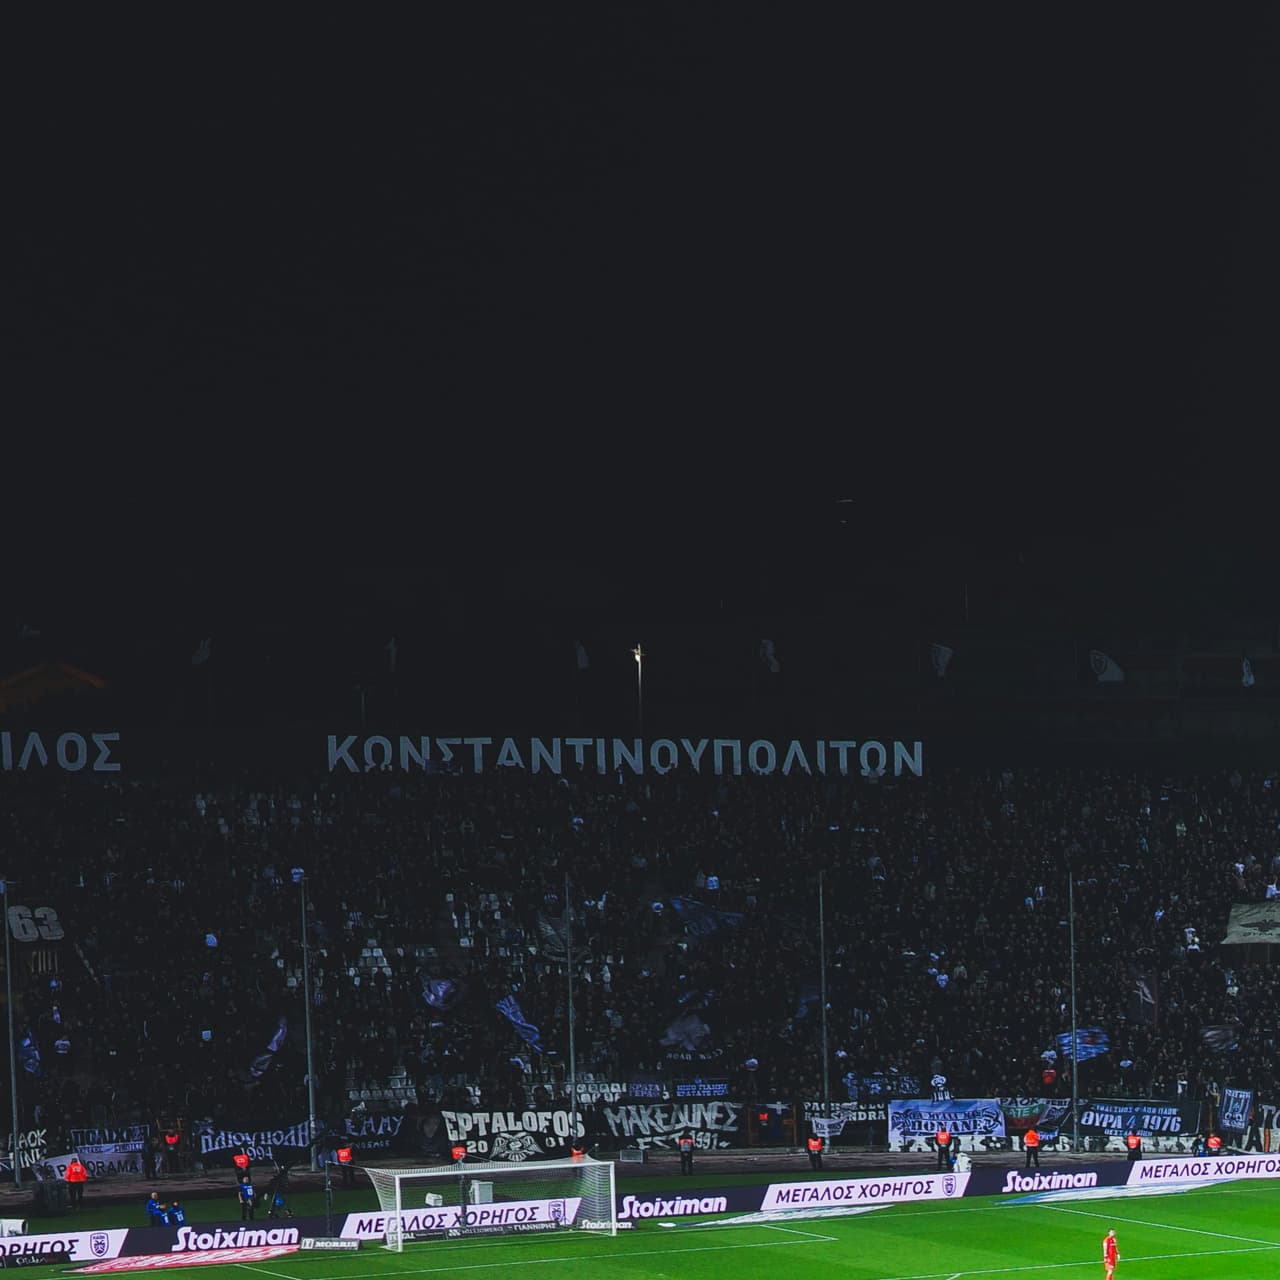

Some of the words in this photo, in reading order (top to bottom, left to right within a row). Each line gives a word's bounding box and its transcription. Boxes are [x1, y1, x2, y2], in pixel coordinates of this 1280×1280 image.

[327, 734, 923, 777] ΚΩΝΣΤΑΝΤΙΝΟΥΠΟΛΙΤΩΝ
[7, 905, 64, 942] 63
[441, 1110, 585, 1142] EPTALOFOS
[1080, 1111, 1123, 1129] ΘΥΡΑ
[1126, 1114, 1138, 1128] 4
[1141, 1114, 1182, 1133] 1976
[1001, 1171, 1098, 1193] Stoiximan
[1140, 1162, 1211, 1179] ΜΕΓΑΛΟΣ
[776, 1185, 855, 1204] ΜΕΓΑΛΟΣ
[859, 1180, 935, 1199] ΧΟΡΗΓΟΣ
[452, 1206, 539, 1228] ΧΟΡΗΓΟΣ
[618, 1196, 727, 1219] Stoiximan
[172, 1226, 300, 1251] Stoiximan
